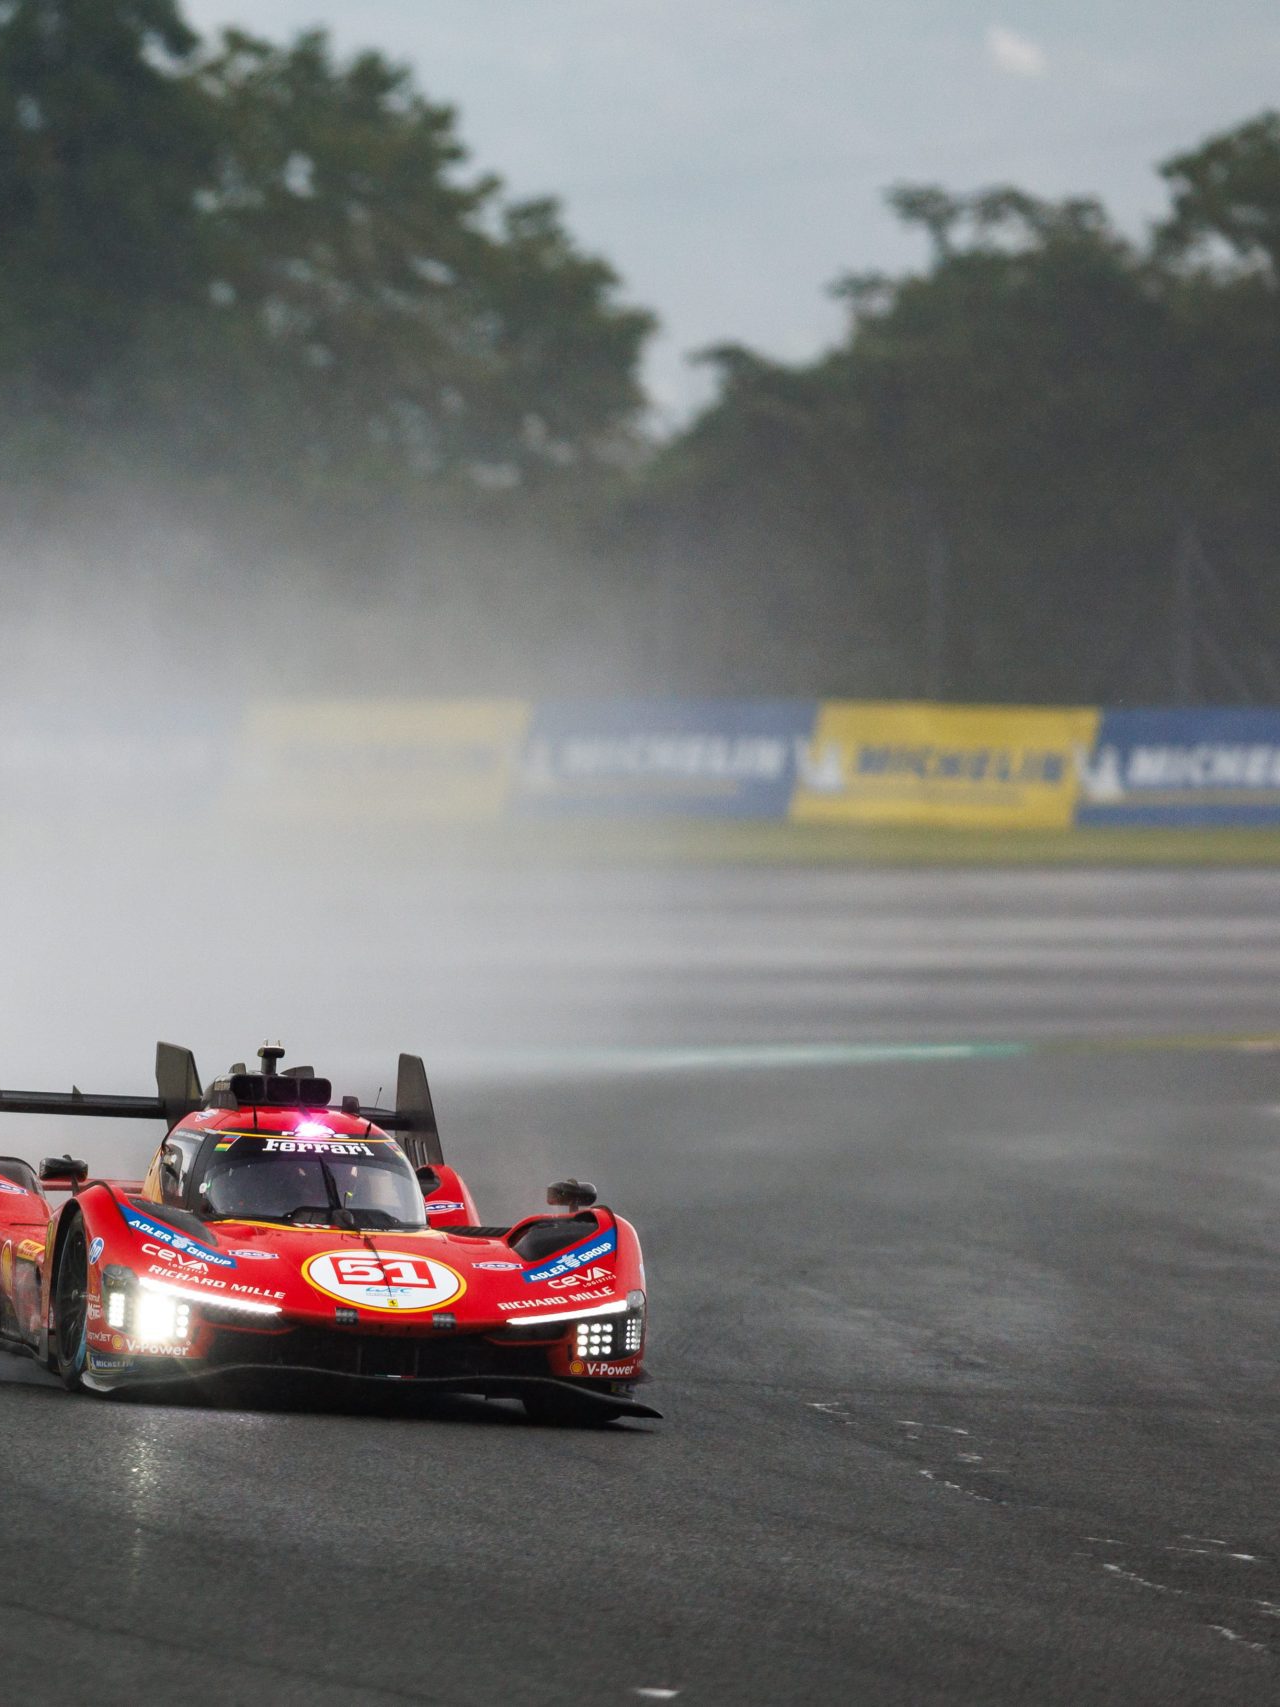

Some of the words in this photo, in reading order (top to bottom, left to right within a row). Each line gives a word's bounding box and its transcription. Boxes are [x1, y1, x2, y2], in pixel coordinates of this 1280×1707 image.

[1128, 745, 1280, 784] MICHE
[262, 1138, 375, 1157] Ferrari
[128, 1219, 172, 1242] ADLER
[186, 1246, 232, 1266] GROUP
[141, 1243, 209, 1272] CEVA
[529, 1264, 569, 1282] ADLER
[578, 1242, 612, 1262] GROUP
[148, 1264, 227, 1289] RICHARD
[230, 1283, 286, 1300] MILLE
[337, 1259, 429, 1285] 51
[548, 1266, 612, 1289] CEVA
[497, 1295, 568, 1311] RICHARD
[568, 1285, 615, 1302] MILLE
[126, 1338, 189, 1356] V-Power
[586, 1363, 634, 1376] V-Power
